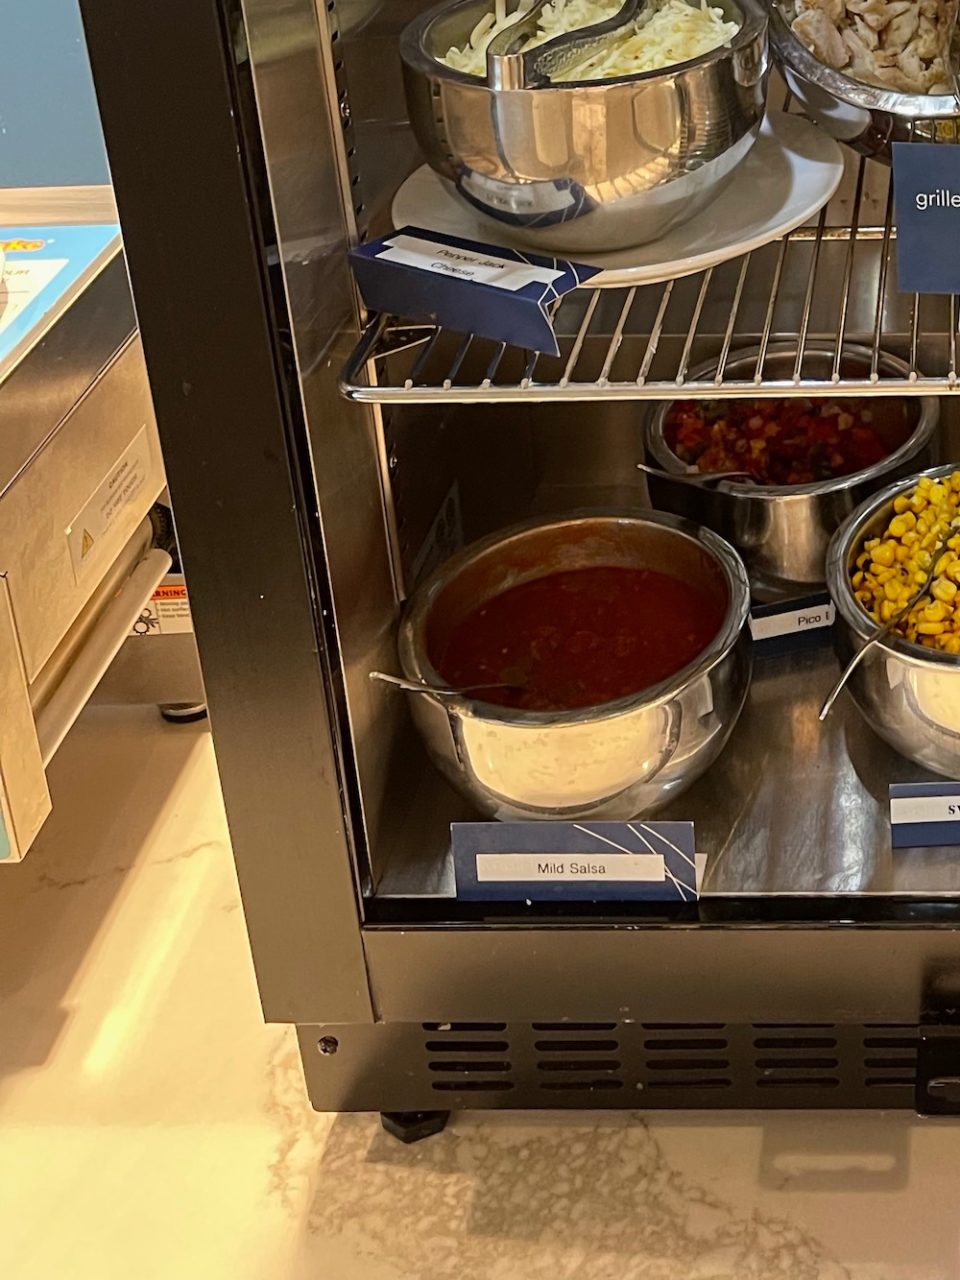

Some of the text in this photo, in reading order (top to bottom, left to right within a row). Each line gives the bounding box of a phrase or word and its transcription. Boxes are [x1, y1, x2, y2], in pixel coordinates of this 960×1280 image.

[435, 249, 505, 270] Pepper Jack
[430, 262, 475, 276] Cheese
[797, 614, 822, 626] Pico
[537, 862, 607, 875] Mild Salsa
